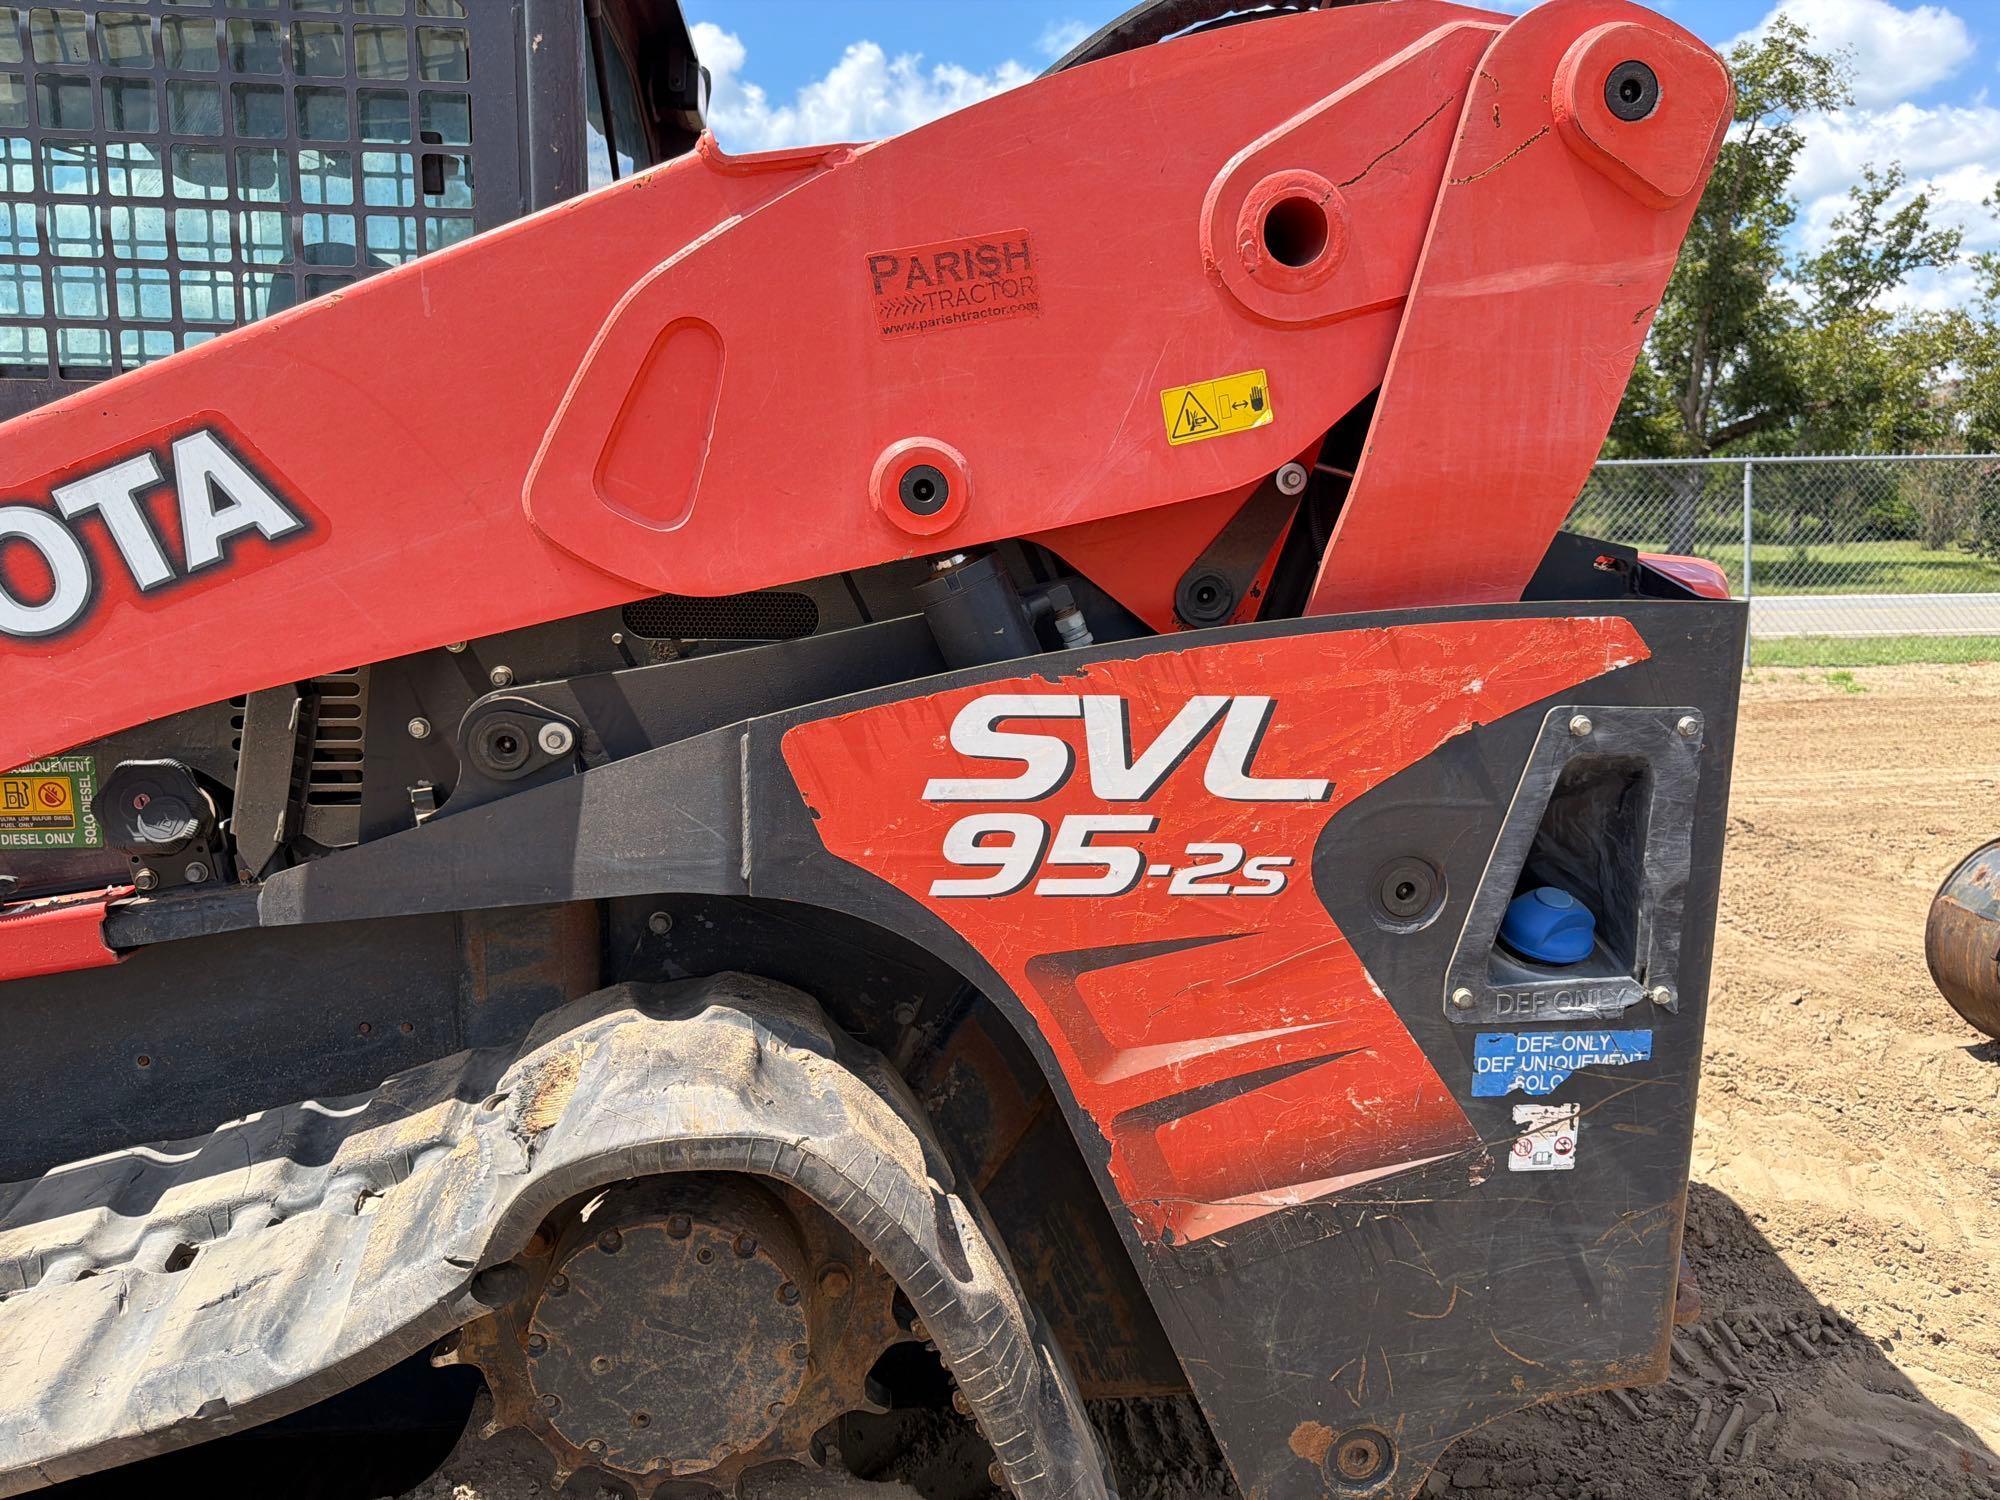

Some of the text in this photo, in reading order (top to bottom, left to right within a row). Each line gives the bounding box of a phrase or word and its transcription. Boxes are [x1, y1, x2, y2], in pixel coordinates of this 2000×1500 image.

[868, 240, 1031, 295] PARISH
[923, 276, 1035, 311] TRACTOR
[882, 302, 1038, 335] www.parishtractor.com
[921, 694, 1334, 802] SVL
[79, 775, 97, 844] SOLO DIESEL
[1, 833, 75, 845] DIESEL ONLY
[1496, 987, 1627, 1015] DEF ONLY
[1516, 1035, 1611, 1053] DEF ONLY
[1477, 1056, 1515, 1073] DEF
